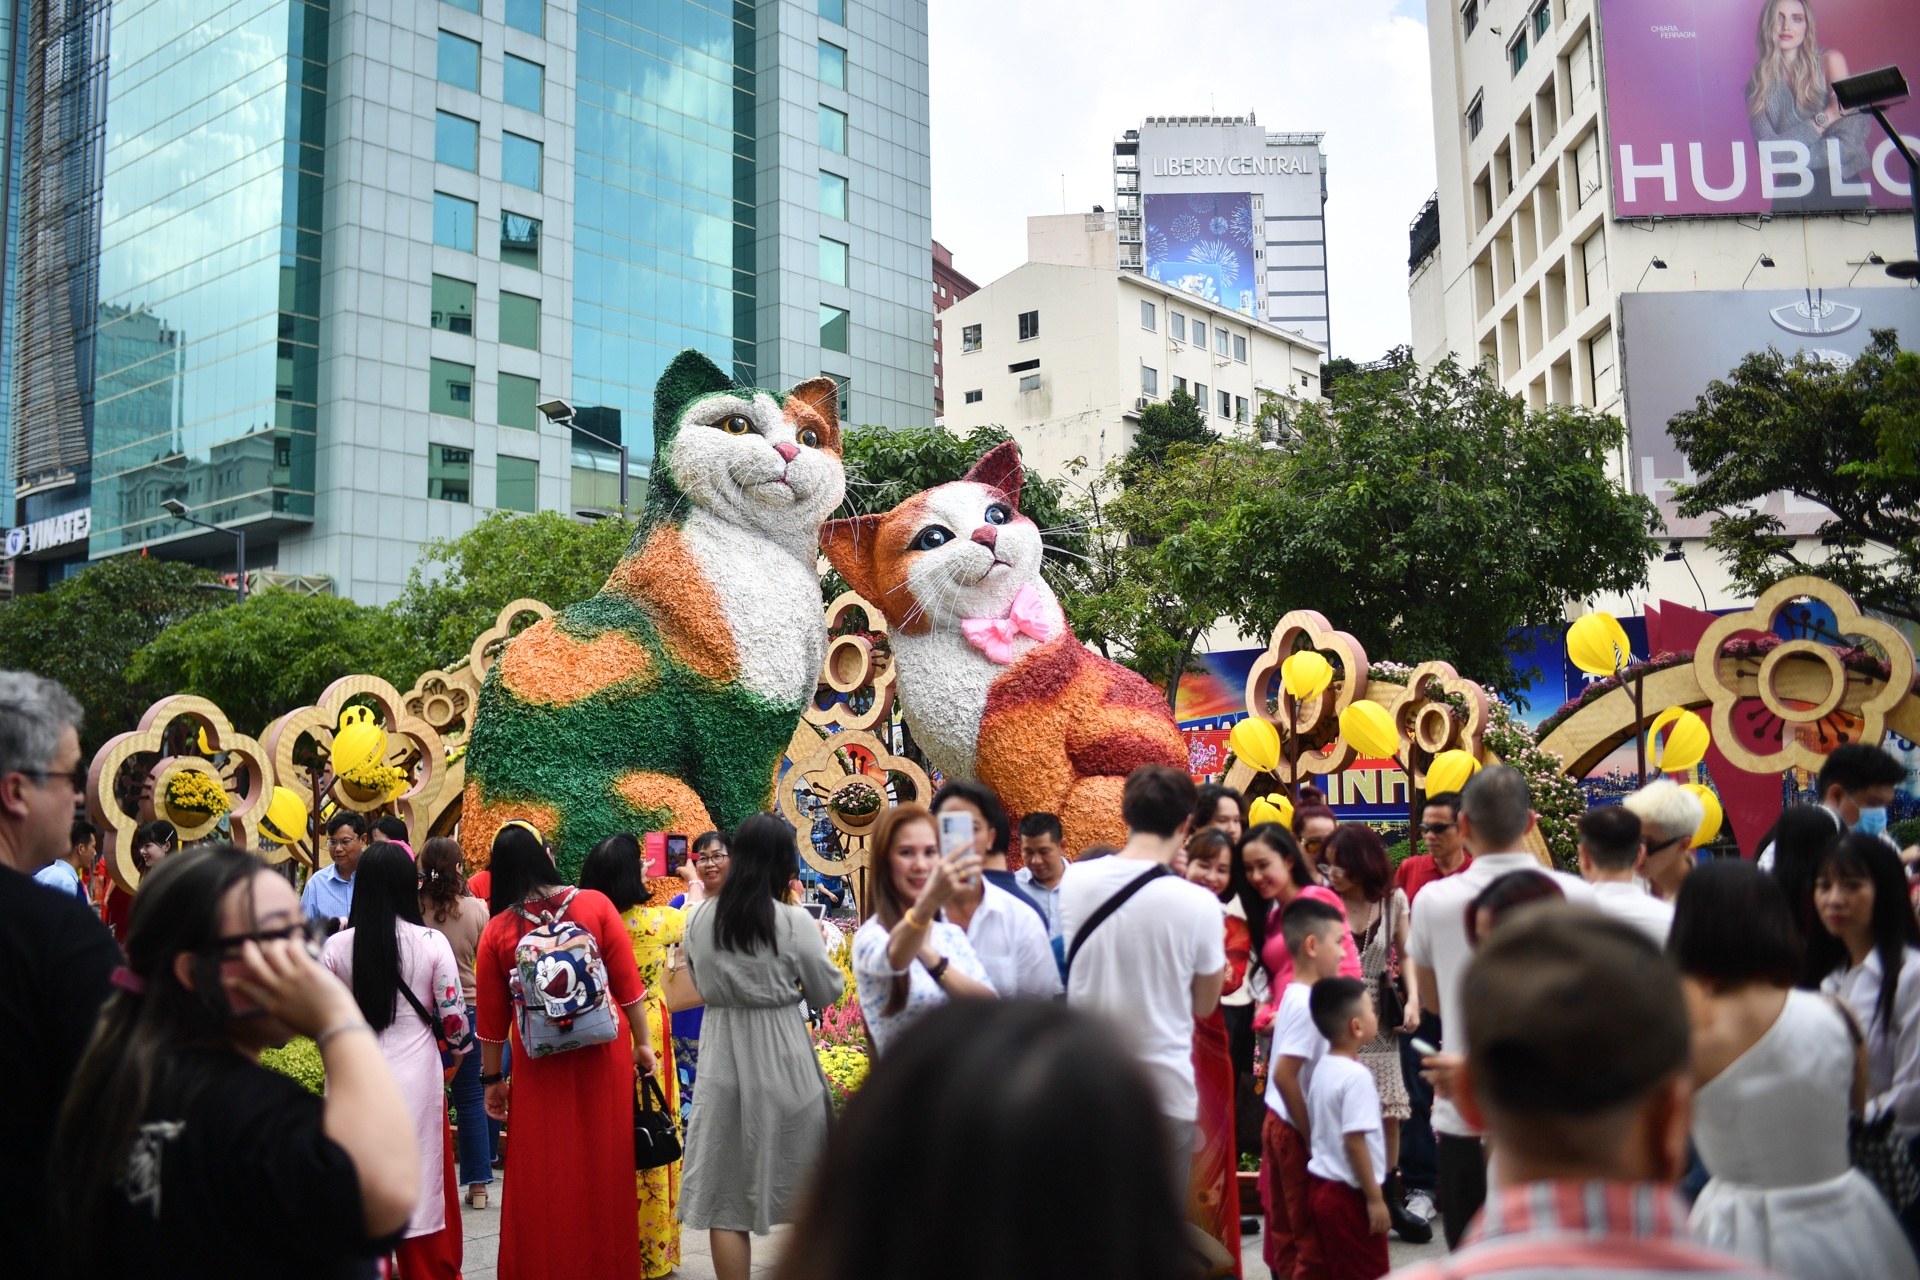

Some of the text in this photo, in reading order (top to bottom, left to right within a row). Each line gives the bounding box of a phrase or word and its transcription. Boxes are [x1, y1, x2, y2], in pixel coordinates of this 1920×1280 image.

[1650, 25, 1678, 33] CHIARA
[1660, 31, 1696, 39] FERRAGNI
[1153, 155, 1313, 177] LIBERTY CENTRAL
